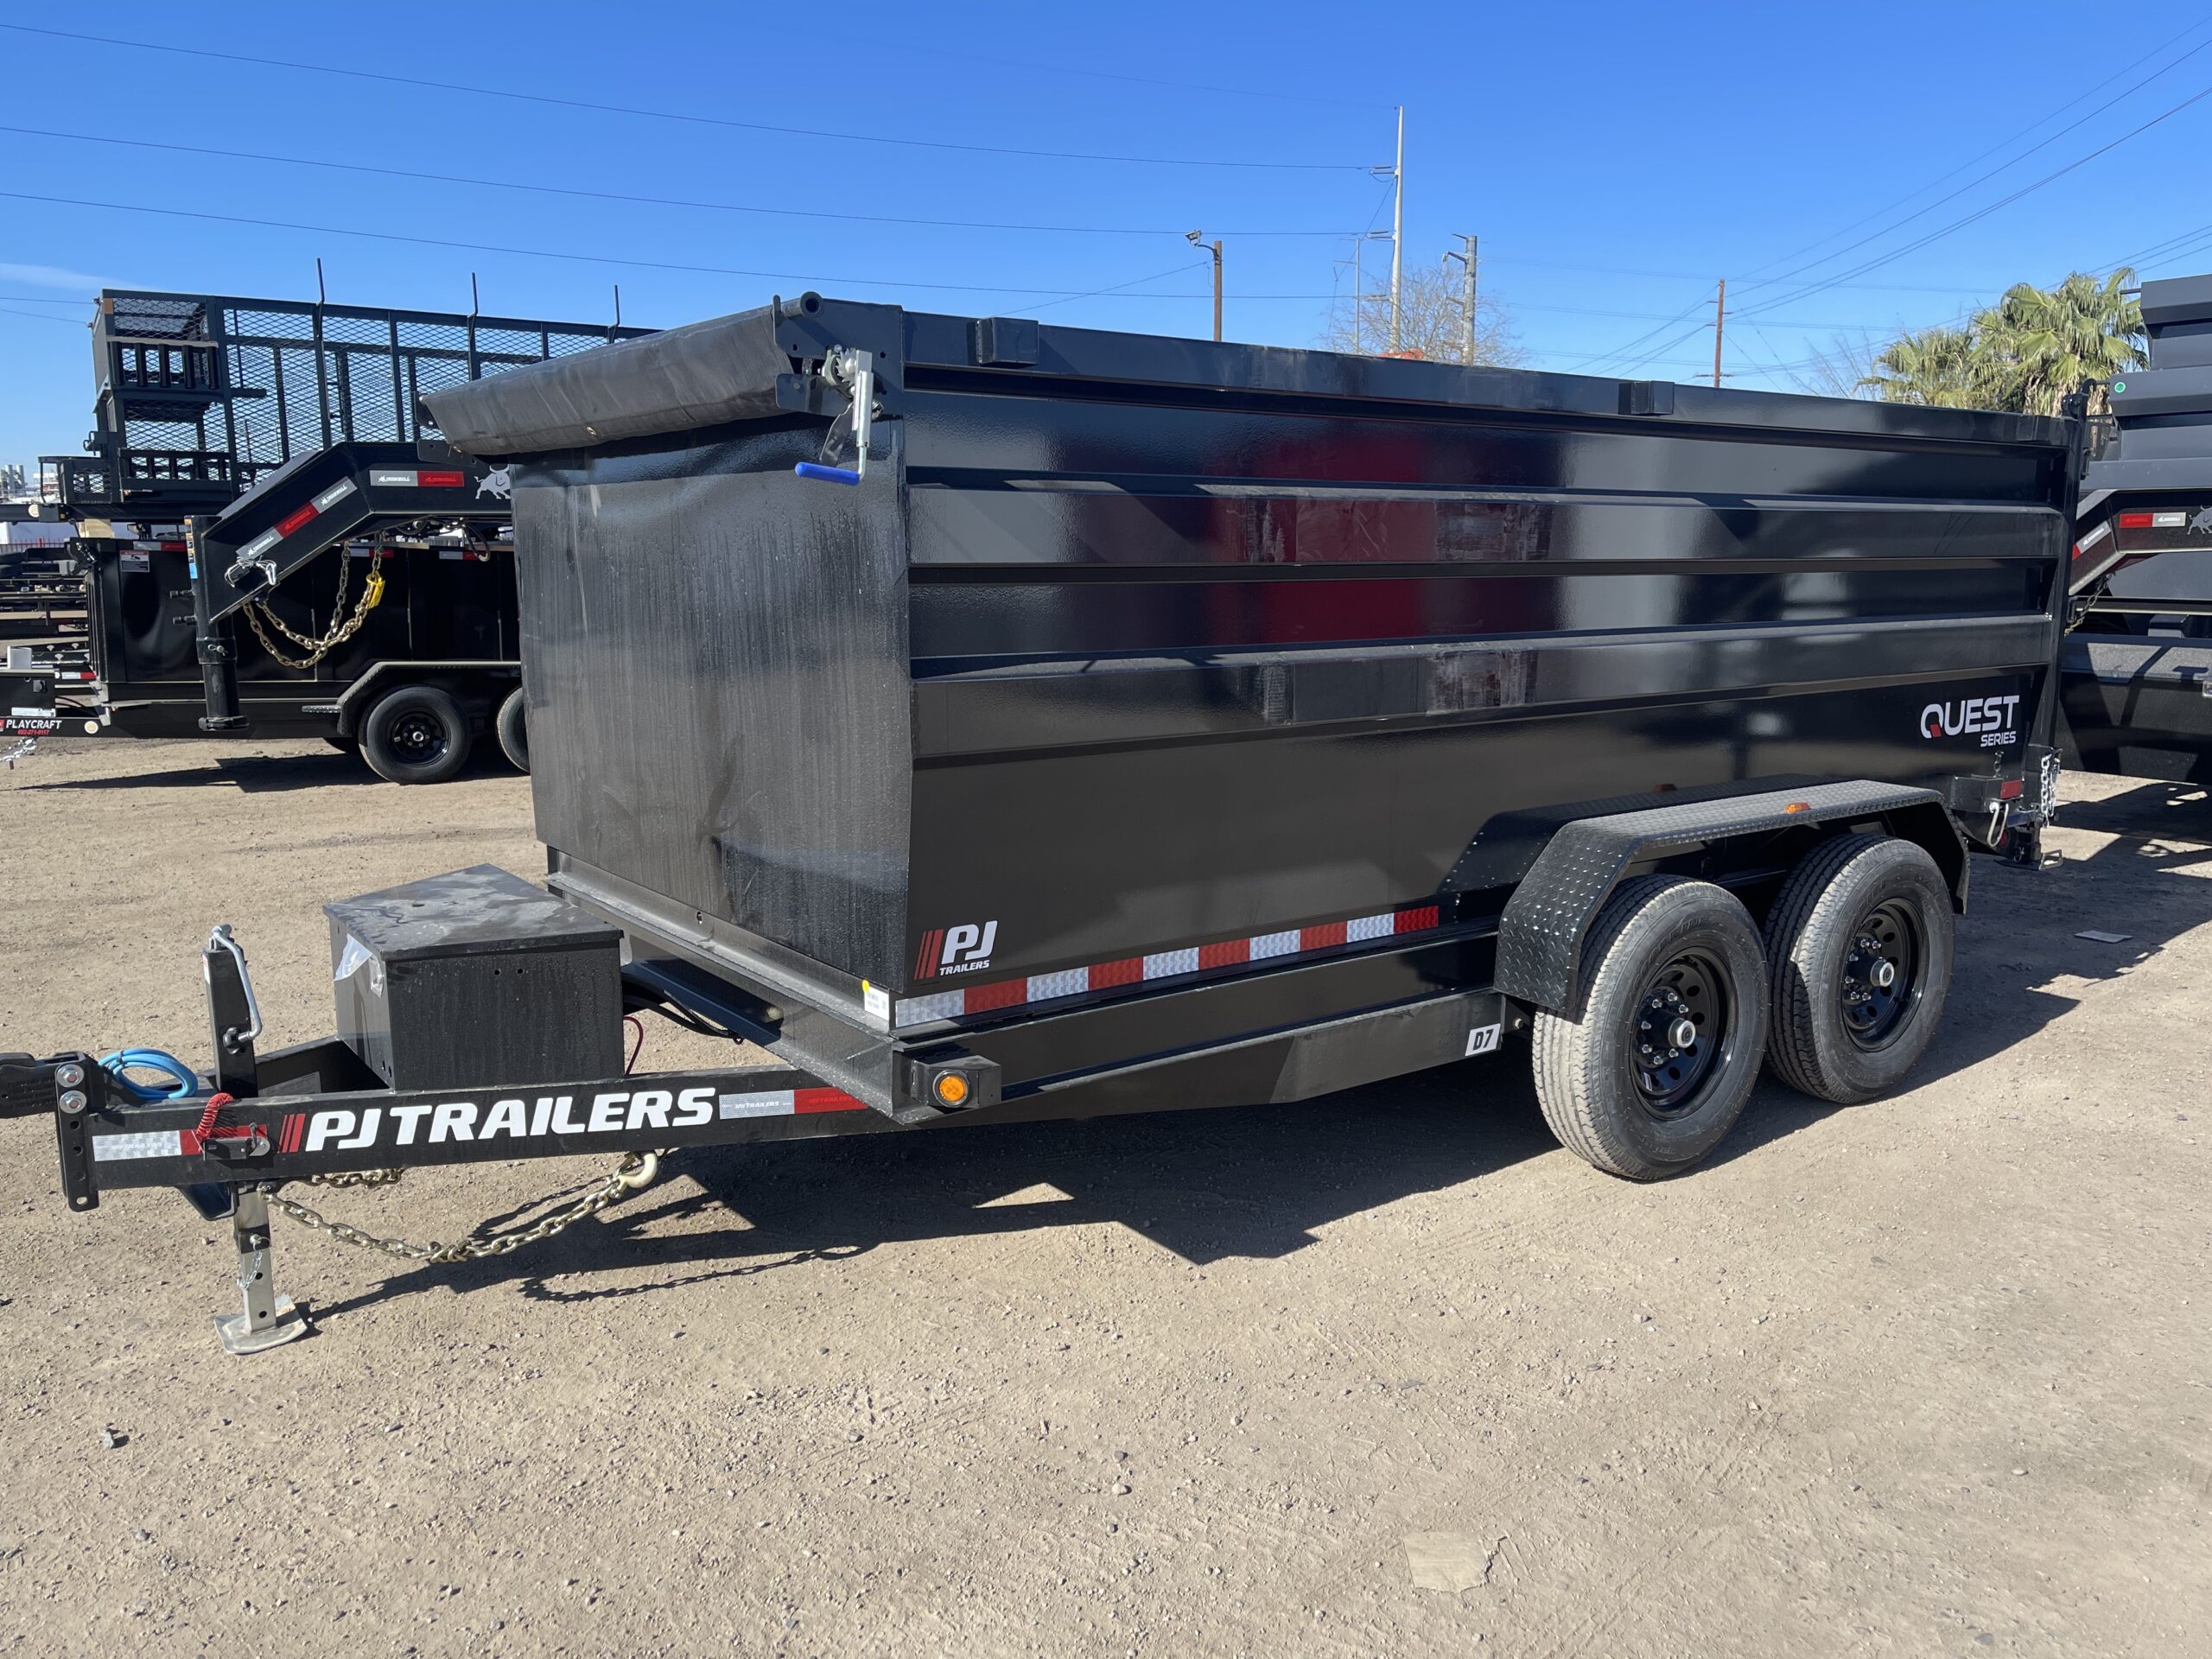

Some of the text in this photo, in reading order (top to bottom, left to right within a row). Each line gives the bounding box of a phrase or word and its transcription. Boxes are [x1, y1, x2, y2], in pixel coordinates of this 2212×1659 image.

[6, 719, 62, 729] PLAYCRAFT
[1920, 695, 2020, 739] QUEST
[1980, 731, 2017, 747] SERIES
[941, 920, 998, 965] PJ
[939, 959, 990, 976] TRAILERS
[304, 1087, 716, 1153] PJ TRAILERS
